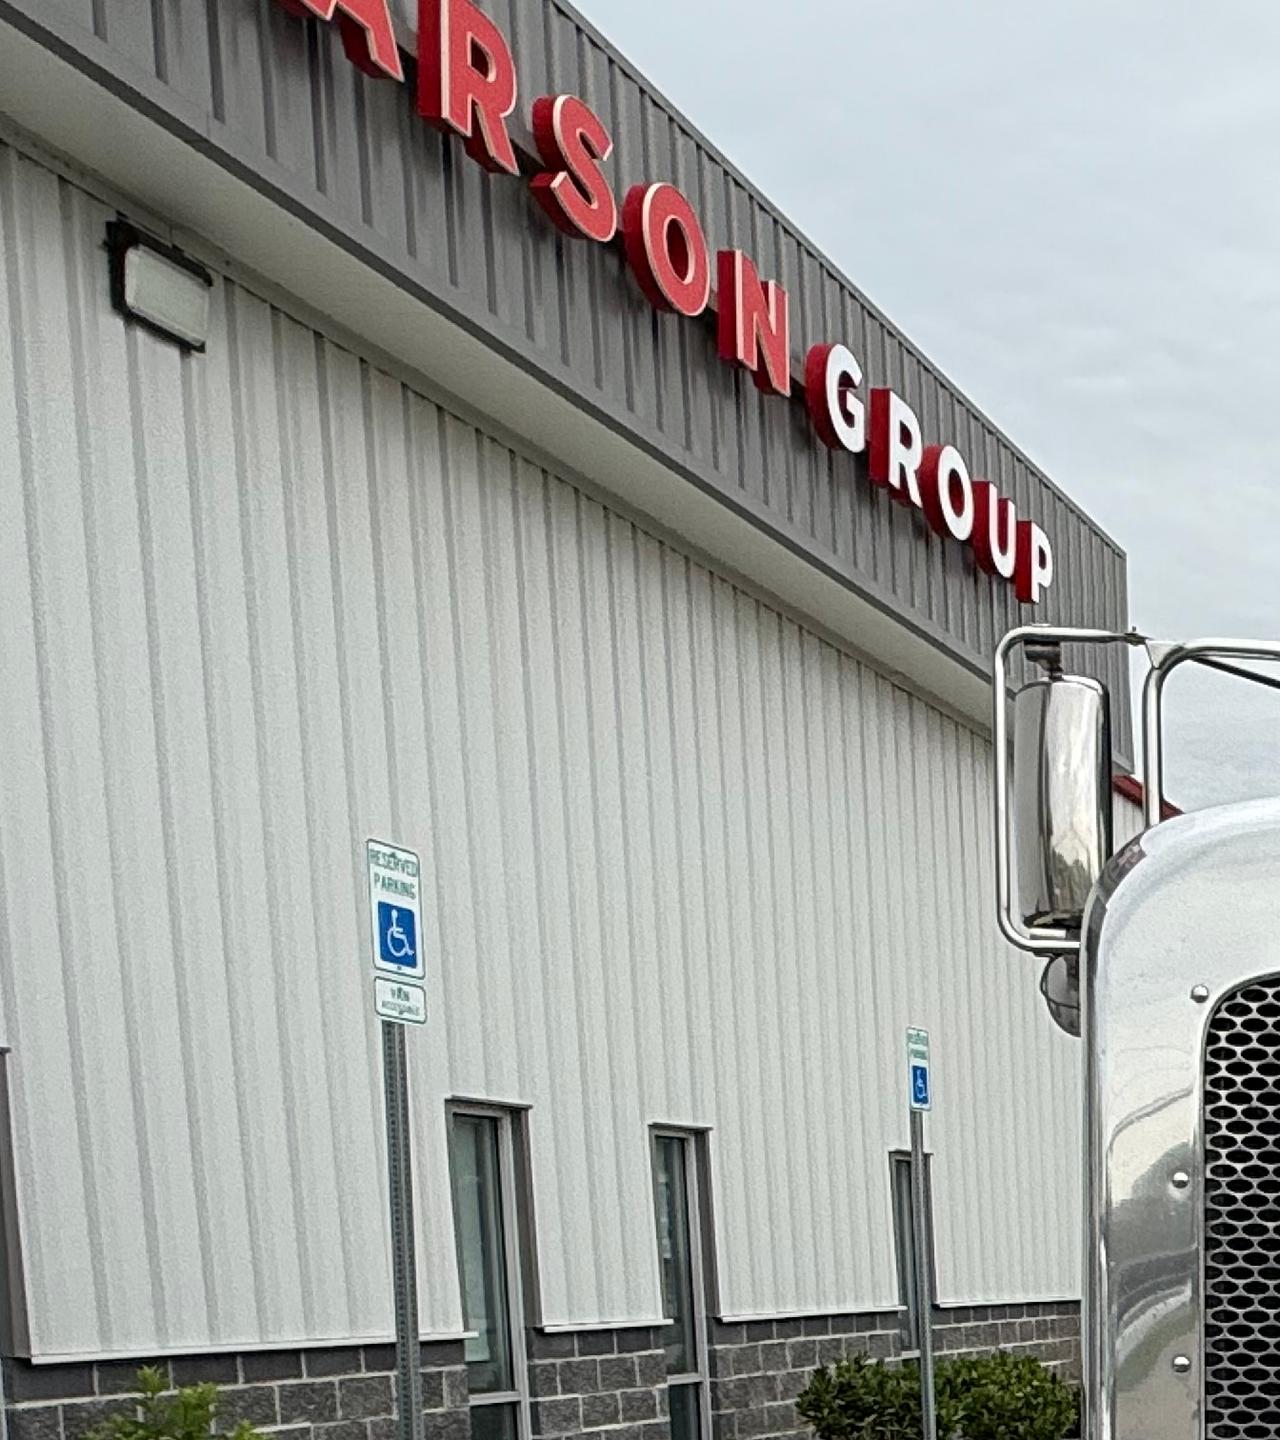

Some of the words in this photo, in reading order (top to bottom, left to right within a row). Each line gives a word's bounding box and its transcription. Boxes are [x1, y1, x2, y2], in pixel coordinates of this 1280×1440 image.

[806, 342, 1054, 604] GROUP
[369, 849, 417, 877] RESERVED
[373, 872, 416, 900] PARKING
